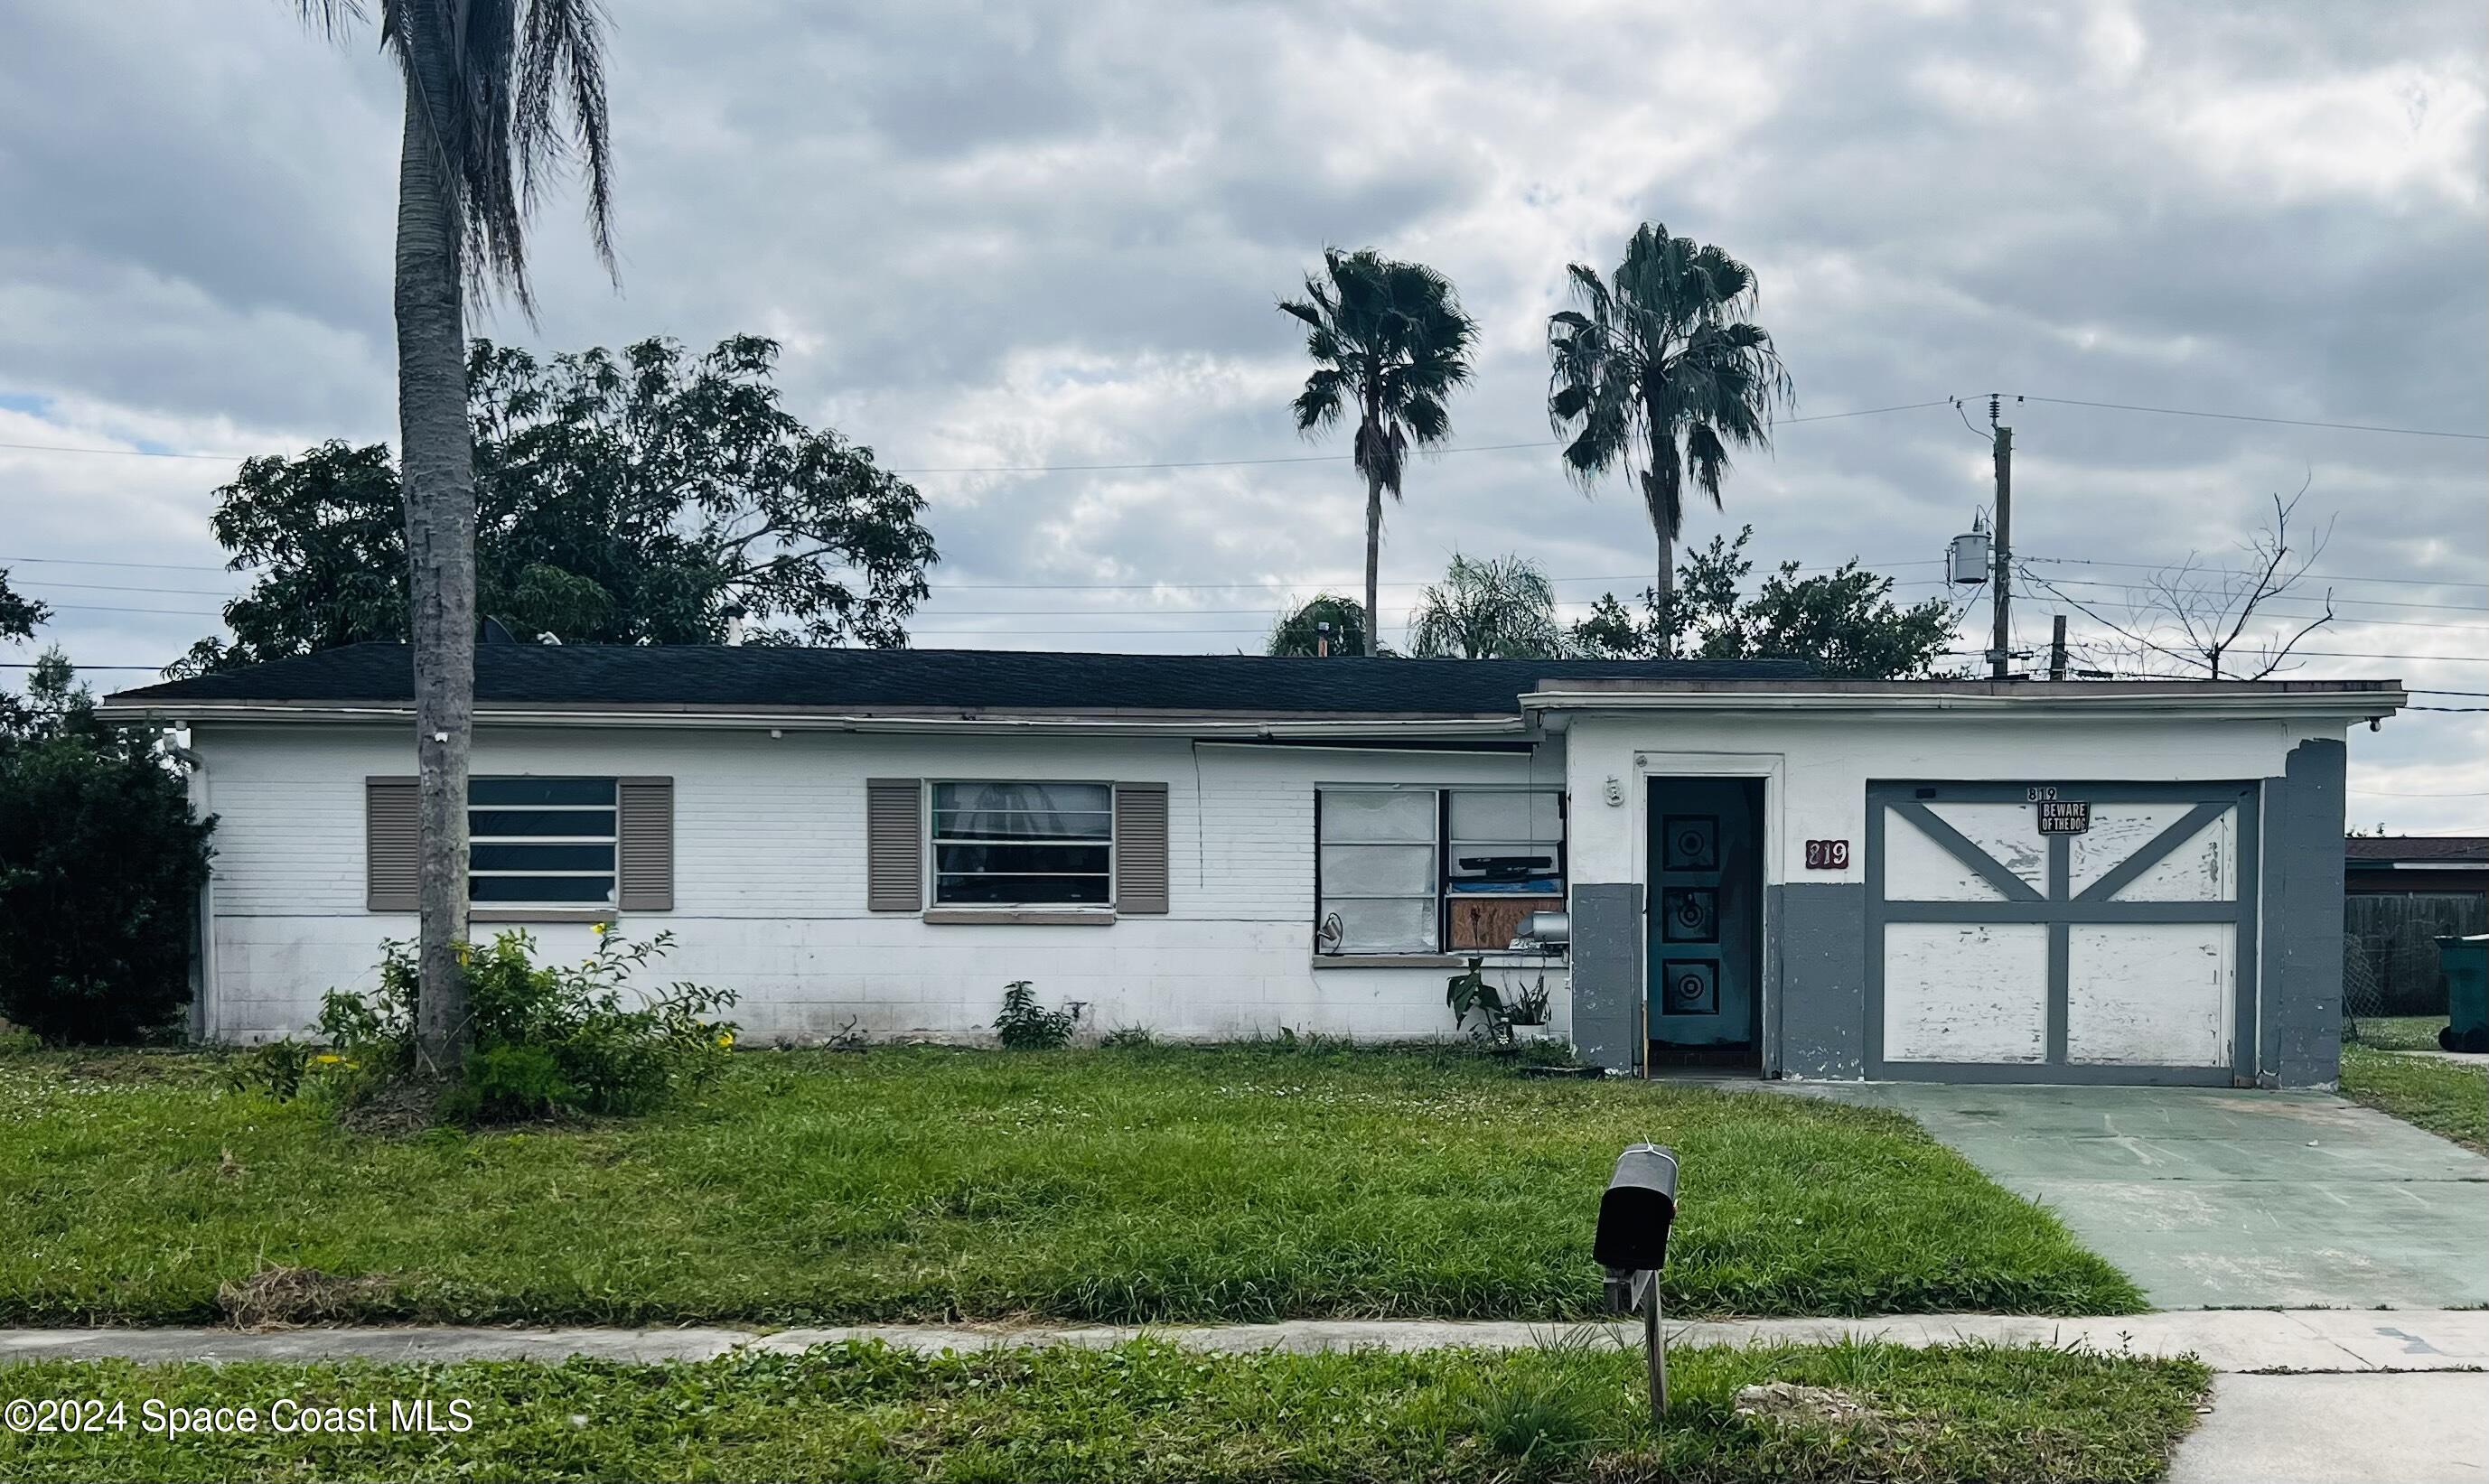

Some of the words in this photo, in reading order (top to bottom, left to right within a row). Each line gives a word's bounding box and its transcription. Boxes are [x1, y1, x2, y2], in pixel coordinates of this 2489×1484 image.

[2028, 788, 2056, 800] 819
[2044, 803, 2085, 817] BEWARE
[2042, 817, 2053, 831] OF
[2054, 817, 2070, 830] THE
[2070, 817, 2086, 830] DOG
[1809, 842, 1847, 865] 819
